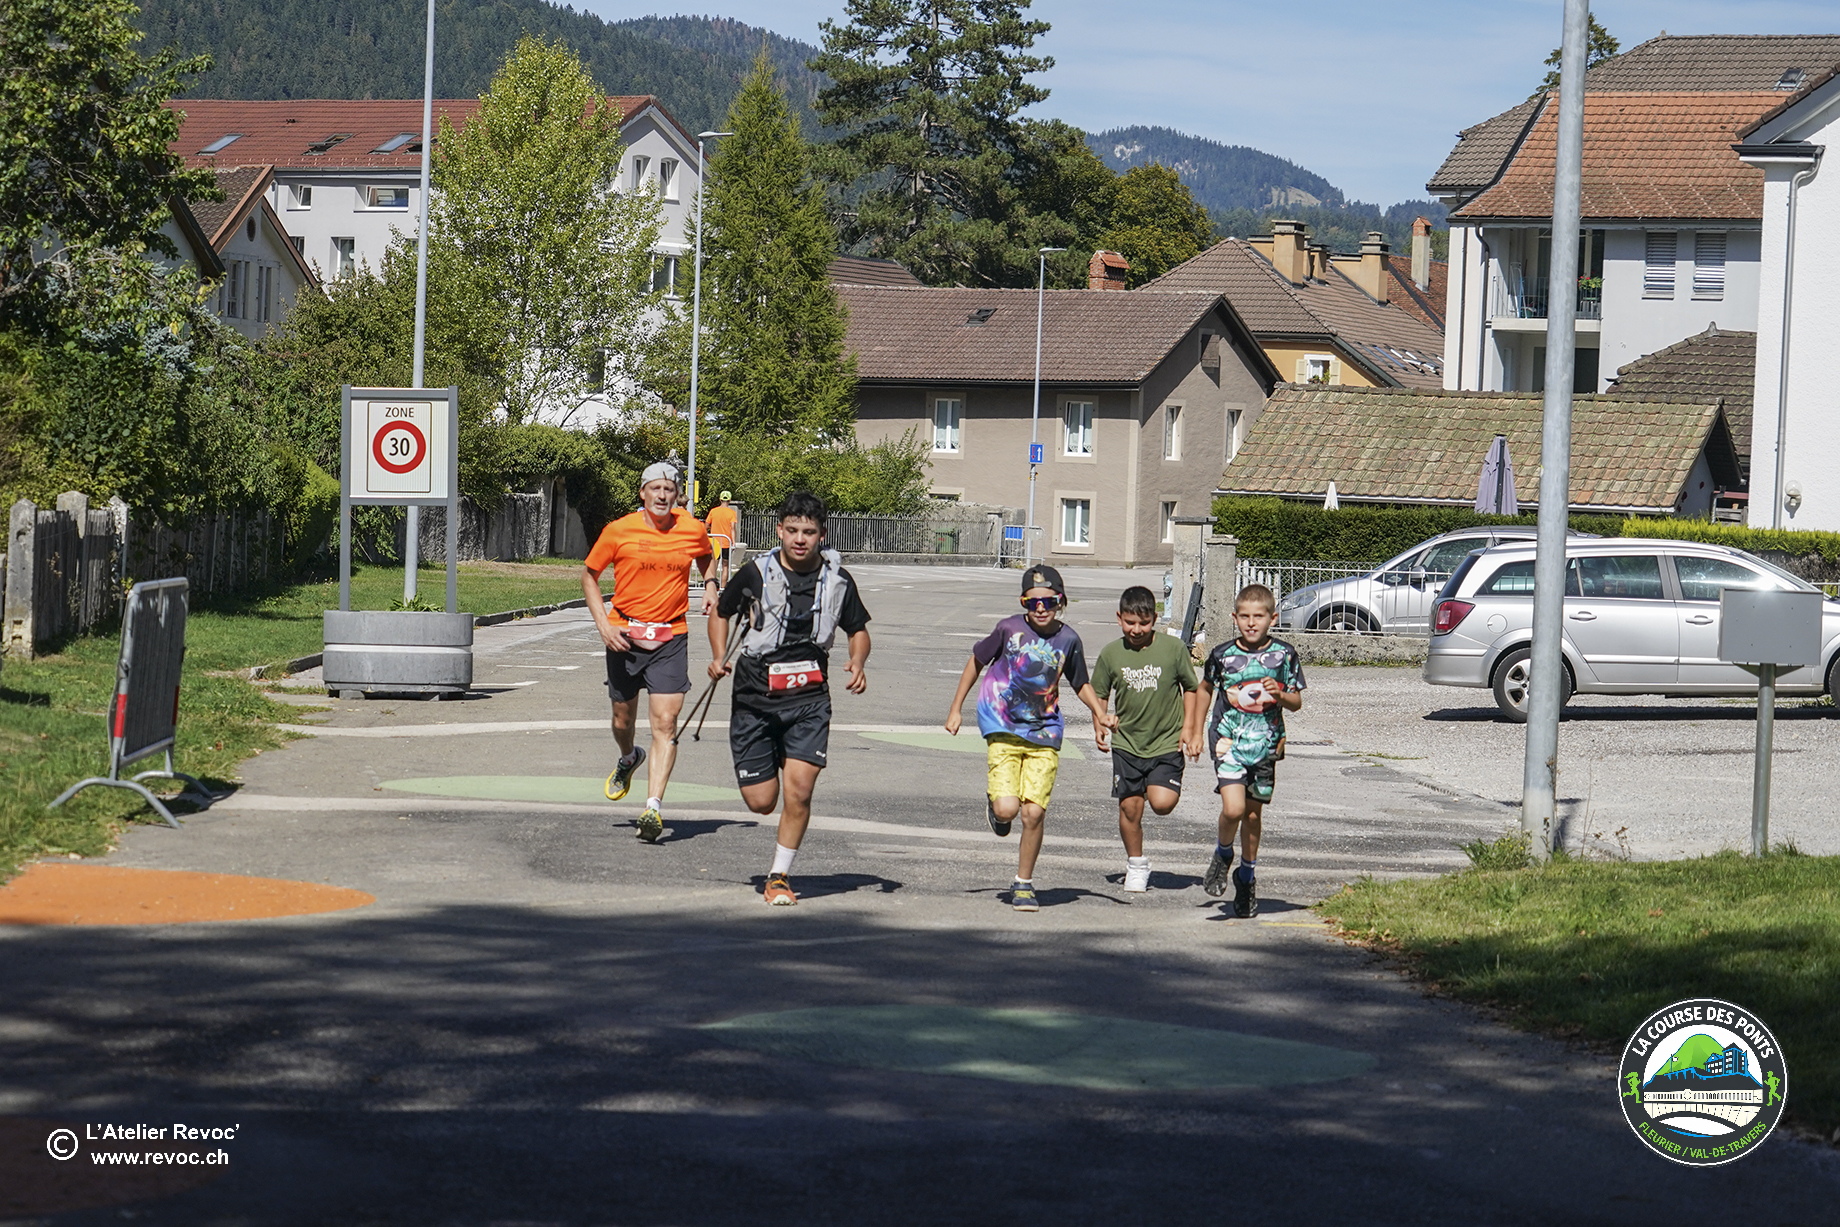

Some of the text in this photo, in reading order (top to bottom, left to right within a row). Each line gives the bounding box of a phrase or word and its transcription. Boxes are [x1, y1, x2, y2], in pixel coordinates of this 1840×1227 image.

[385, 407, 415, 418] ZONE
[389, 437, 410, 457] 30
[1143, 664, 1162, 679] Stop
[785, 673, 808, 689] 29
